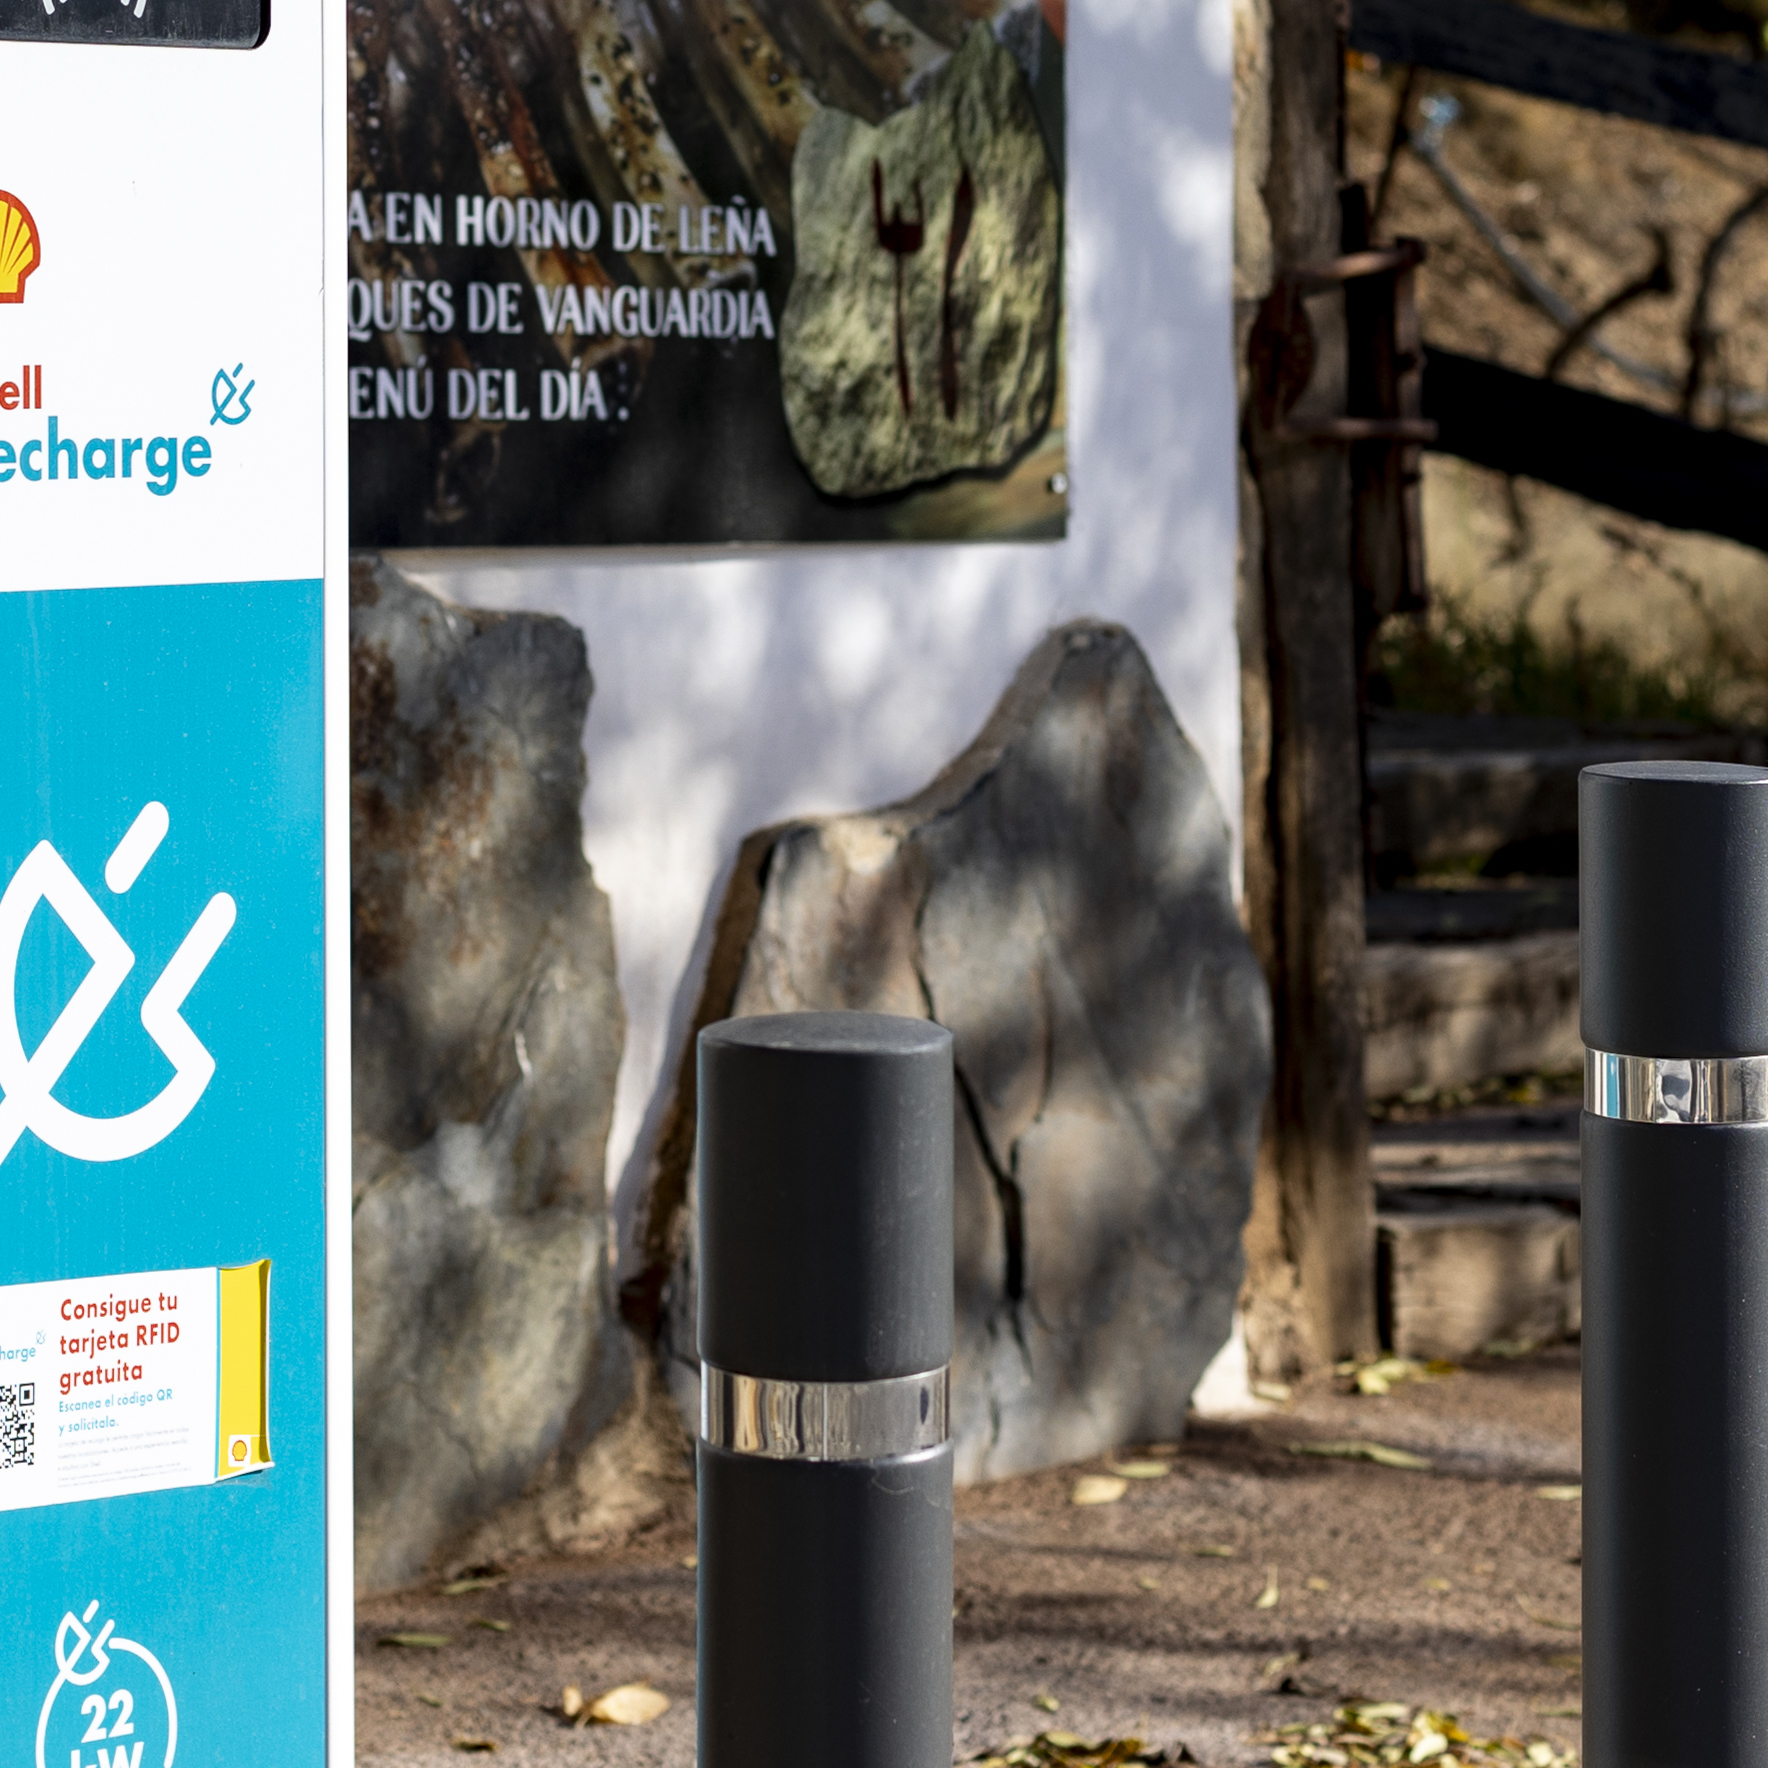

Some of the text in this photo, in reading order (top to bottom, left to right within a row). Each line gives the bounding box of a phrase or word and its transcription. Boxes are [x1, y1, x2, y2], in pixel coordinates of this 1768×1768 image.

[385, 191, 443, 245] EN
[455, 194, 600, 251] HORNO
[612, 199, 665, 254] DE
[678, 195, 778, 257] LEÑA
[467, 280, 524, 334] DE
[536, 283, 775, 339] VANGUARDIA
[447, 367, 530, 421] DEL
[60, 1292, 178, 1322] Consigue tu
[59, 1321, 180, 1359] tarjeta RFID
[59, 1359, 143, 1395] gratuita
[58, 1400, 102, 1413] Escanea
[105, 1394, 114, 1407] el
[156, 1388, 173, 1402] QR
[58, 1425, 65, 1437] y
[80, 1688, 134, 1743] 22
